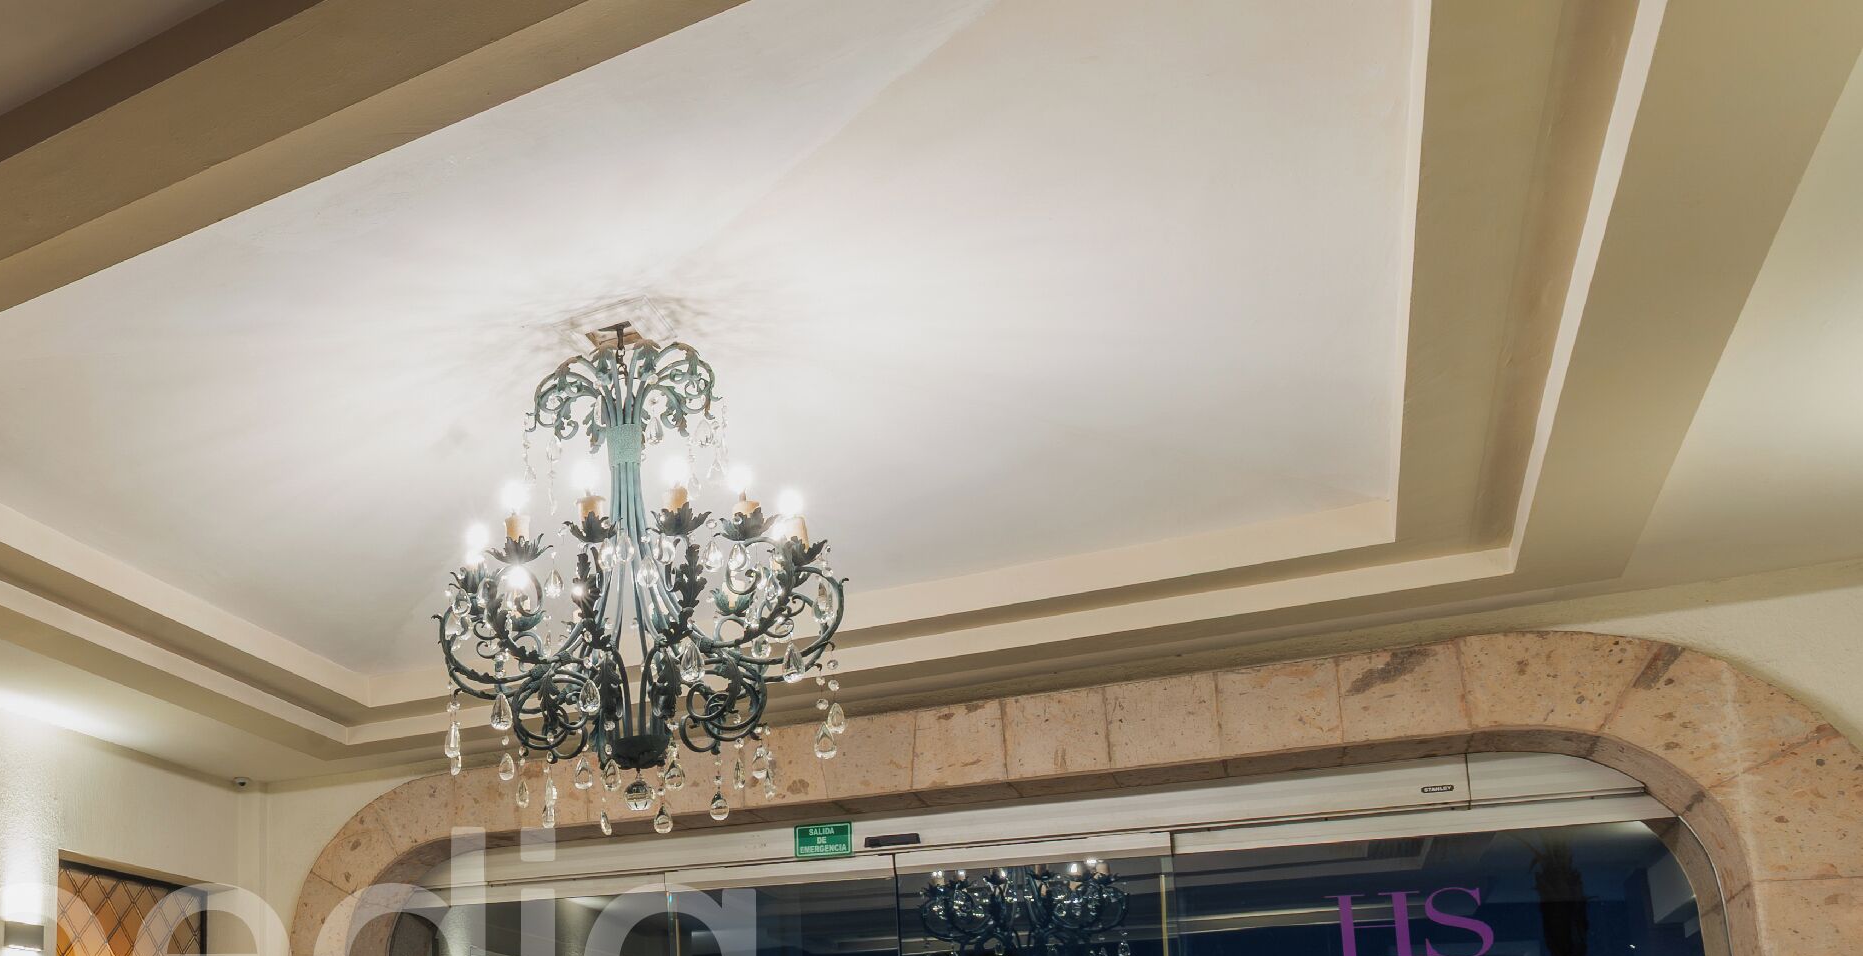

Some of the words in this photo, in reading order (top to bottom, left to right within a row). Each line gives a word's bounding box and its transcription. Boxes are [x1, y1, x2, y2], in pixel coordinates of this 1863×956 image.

[1423, 785, 1452, 793] STANLEY
[809, 826, 835, 836] SALIDA
[817, 836, 828, 844] DE
[800, 843, 848, 854] EMERGENCIA
